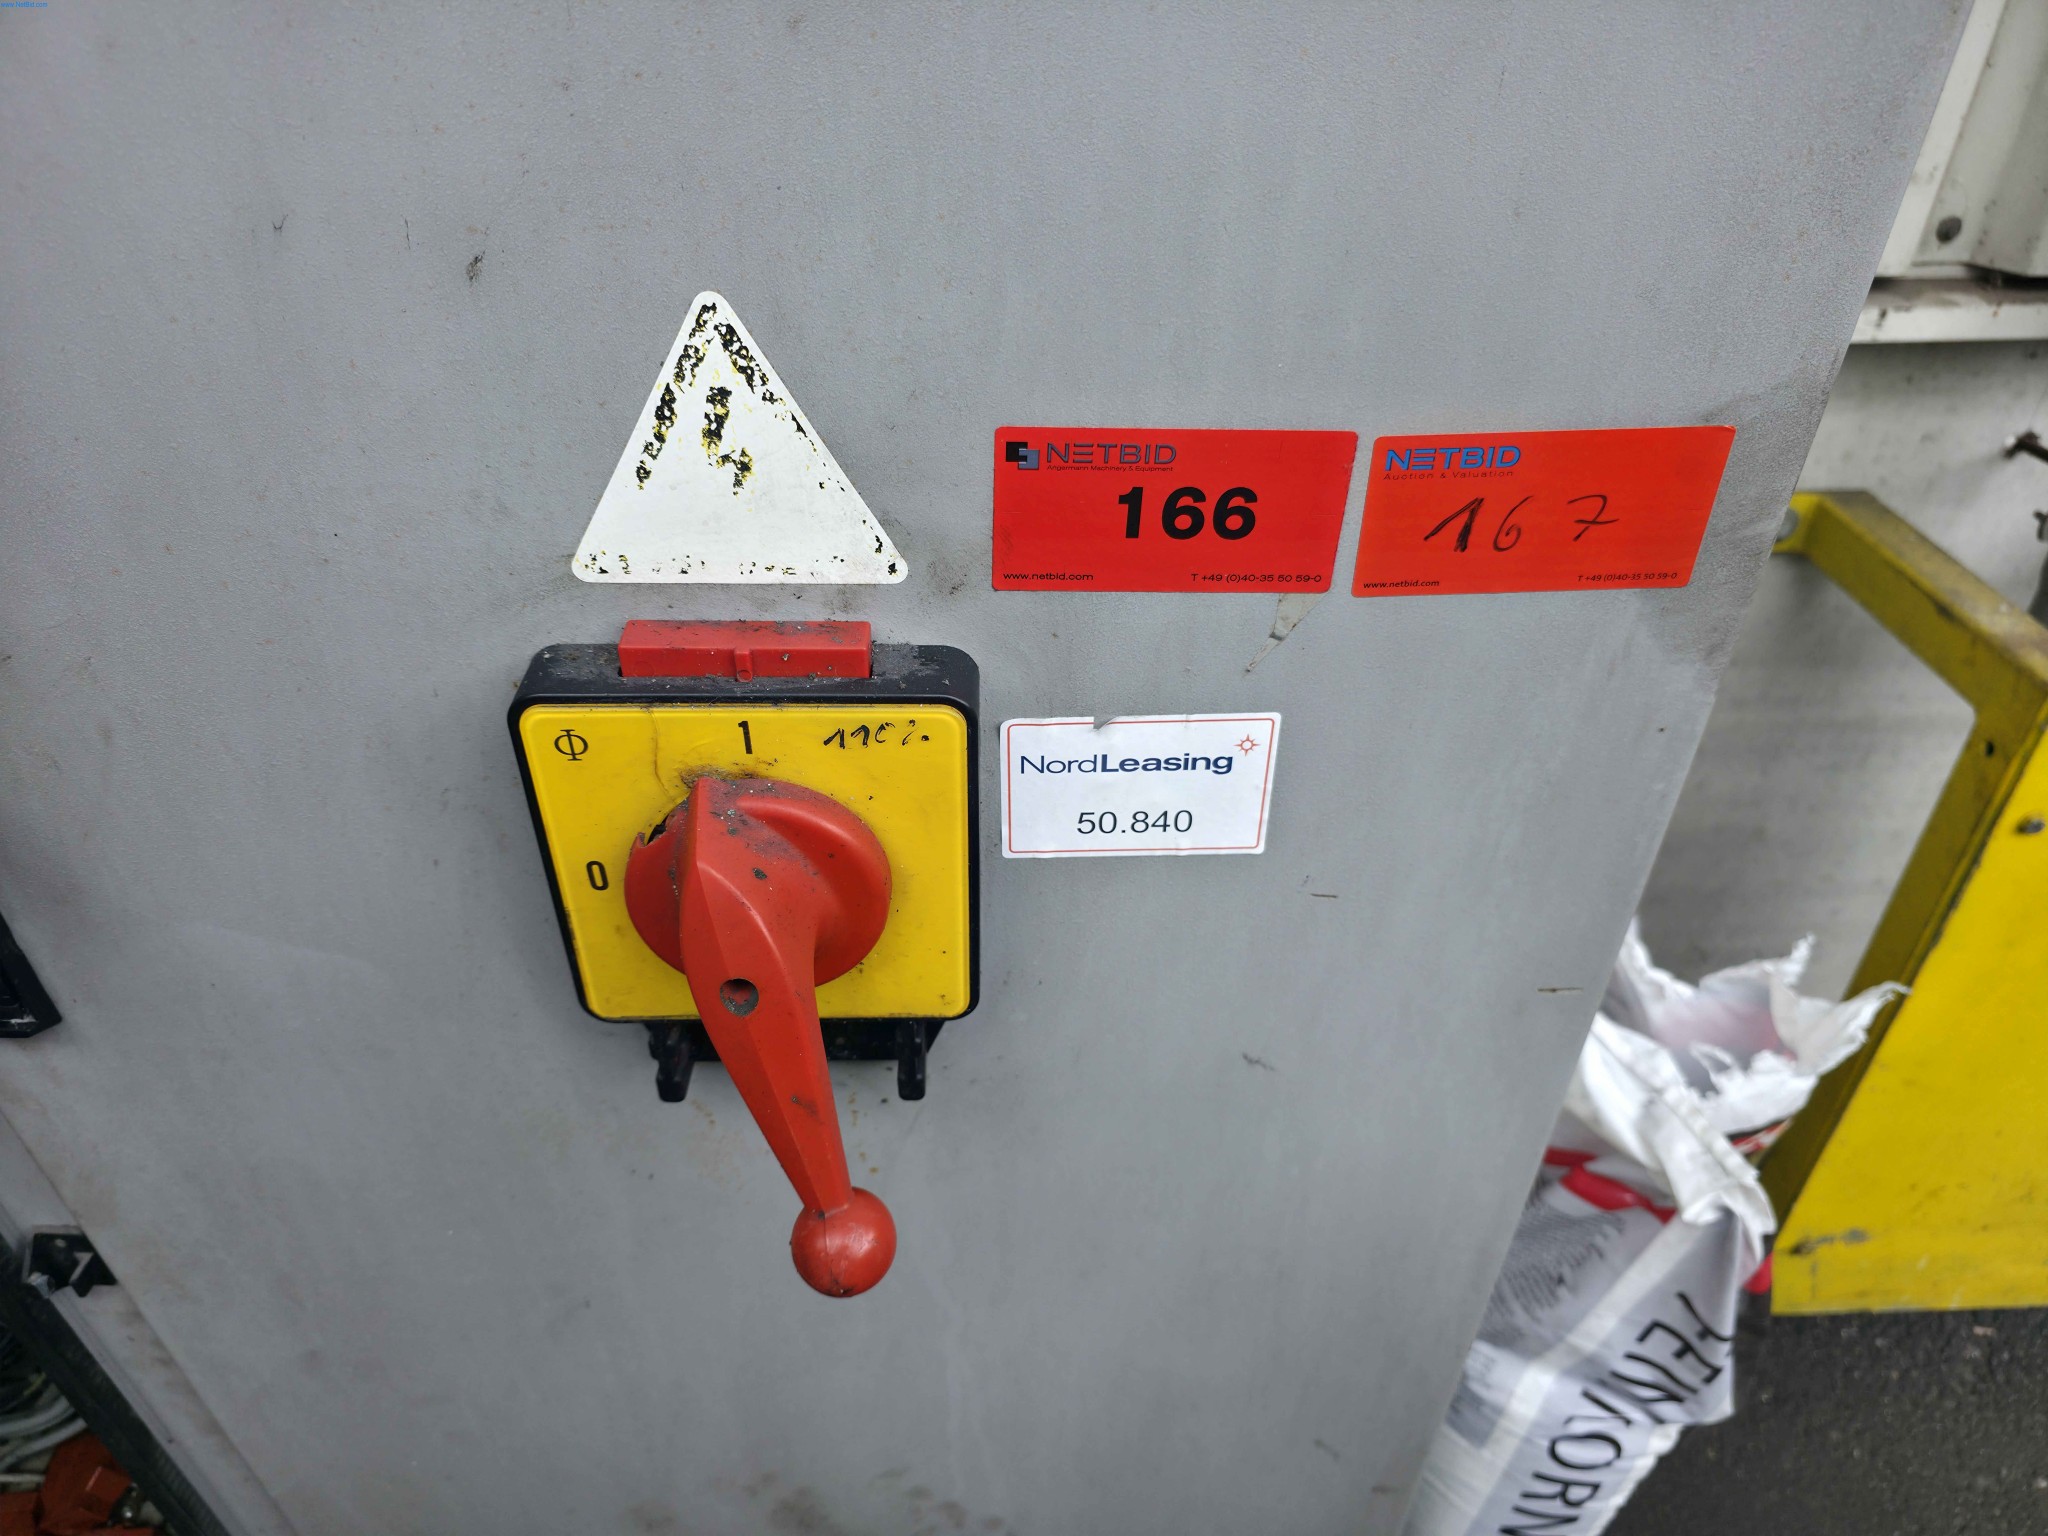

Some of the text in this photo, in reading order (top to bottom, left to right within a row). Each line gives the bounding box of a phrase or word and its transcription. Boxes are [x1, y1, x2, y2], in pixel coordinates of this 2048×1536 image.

[1047, 442, 1177, 465] NETBID
[1385, 445, 1521, 471] NETBID
[1047, 464, 1089, 472] Angermann
[1135, 465, 1173, 473] Equipment
[1452, 470, 1513, 479] Valuation
[1118, 486, 1258, 540] 166
[1003, 573, 1094, 581] www.netbid.com
[1191, 573, 1198, 582] T
[1202, 574, 1222, 582] +49
[1226, 573, 1274, 583] (0)40-35
[1295, 574, 1322, 582] 59-0
[1363, 580, 1440, 588] www.netbid.com
[1603, 573, 1641, 582] (0)40-35
[1657, 572, 1677, 580] 59-0
[738, 720, 753, 754] 1
[1020, 753, 1233, 775] NordLeasing
[1076, 810, 1193, 834] 50.840
[586, 860, 609, 891] 0
